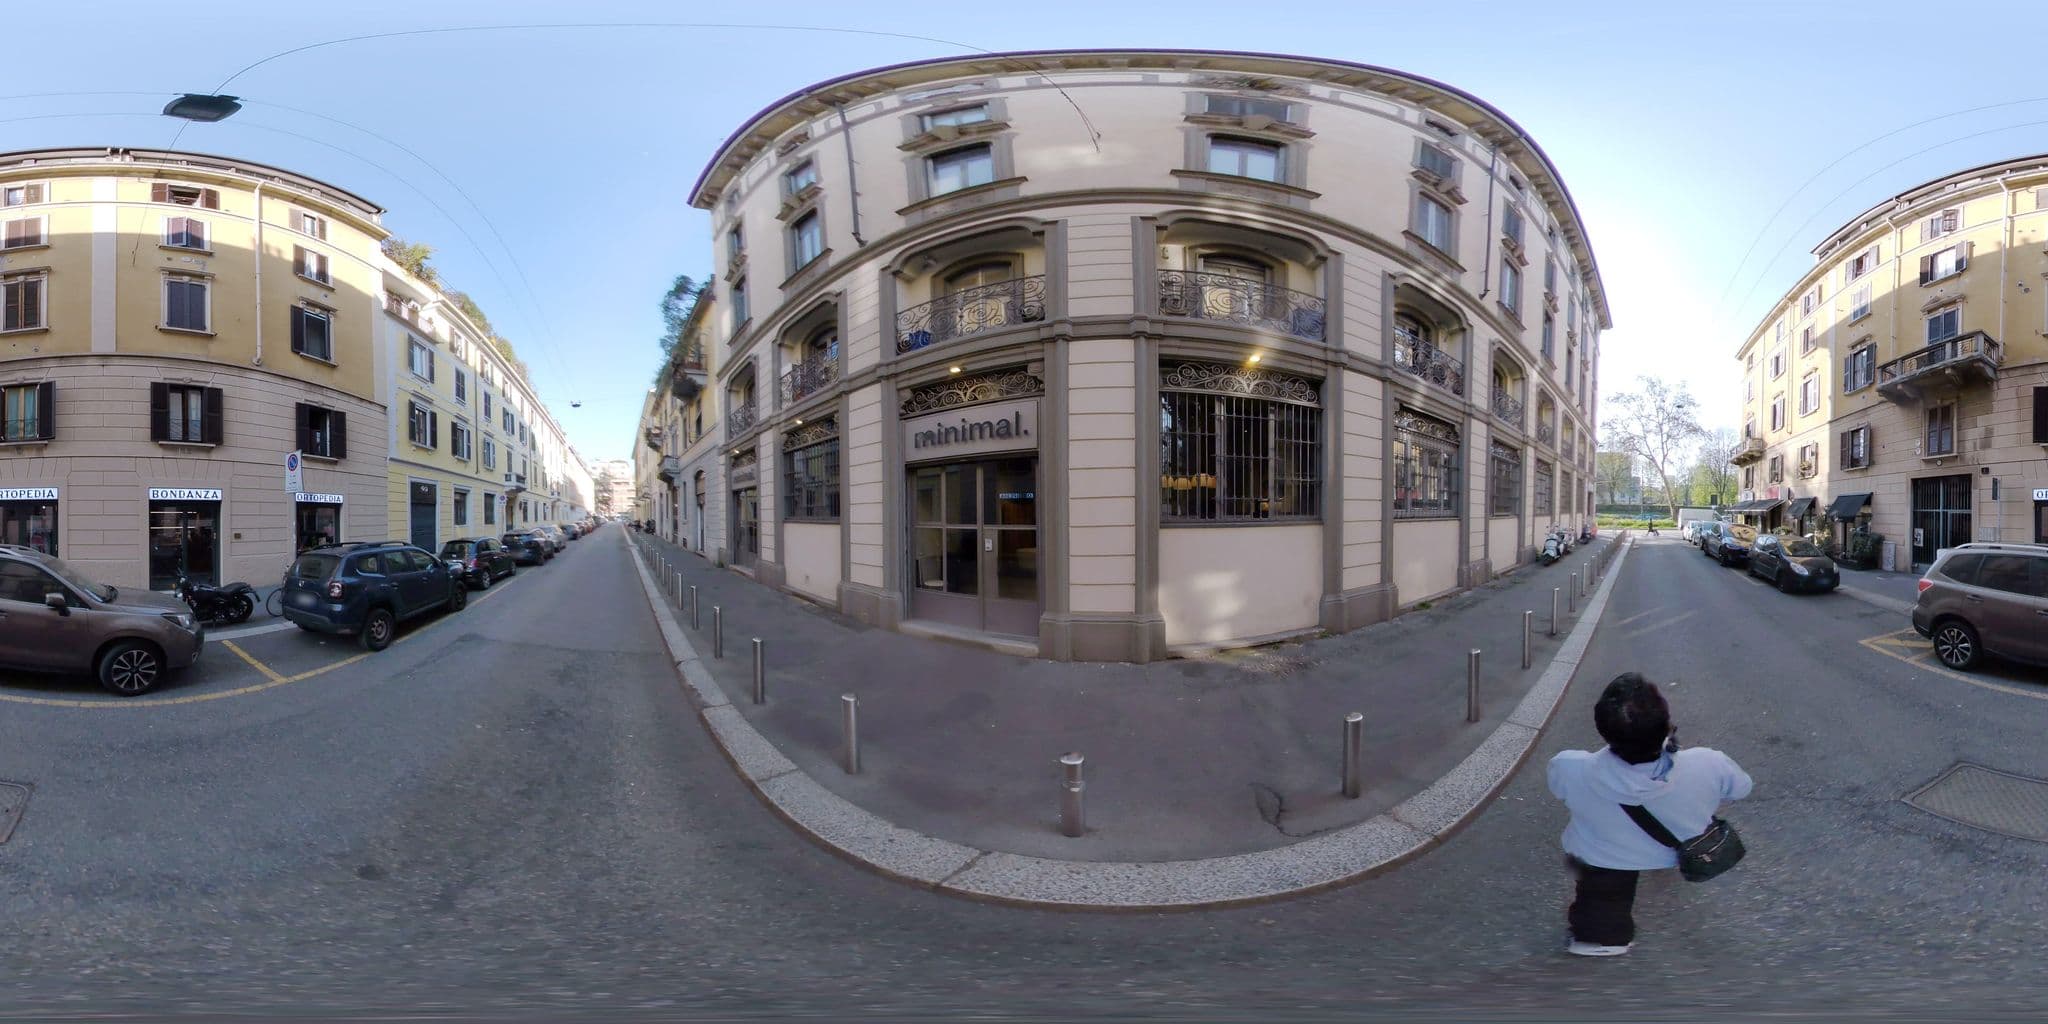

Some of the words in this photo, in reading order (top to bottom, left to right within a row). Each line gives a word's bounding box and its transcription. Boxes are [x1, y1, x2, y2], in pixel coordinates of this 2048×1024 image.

[914, 411, 1029, 448] minimal.
[152, 490, 218, 499] BONDANZA
[297, 494, 341, 502] ORTOPEDIA
